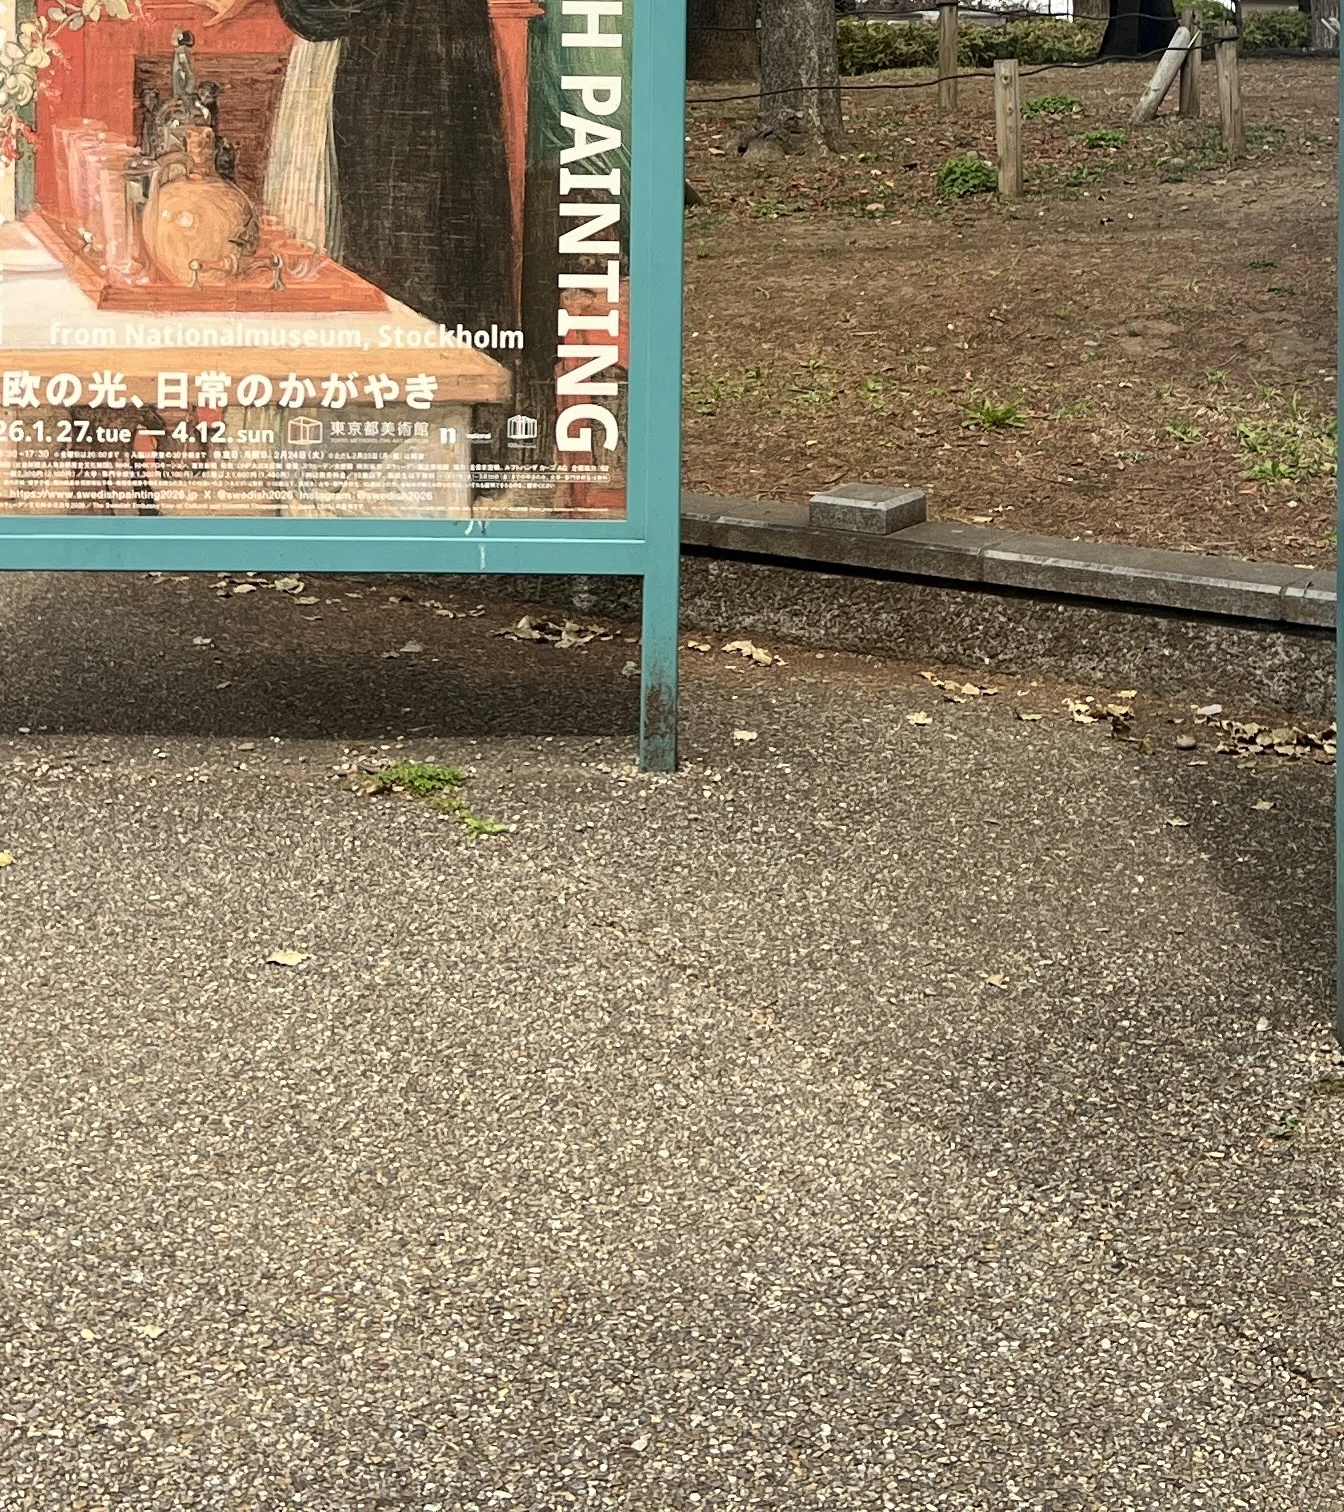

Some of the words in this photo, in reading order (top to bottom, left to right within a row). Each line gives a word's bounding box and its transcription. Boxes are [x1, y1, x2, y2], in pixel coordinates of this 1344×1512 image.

[555, 76, 623, 454] PAINTING
[50, 322, 118, 347] from
[125, 322, 369, 352] Nationalmuseum,
[378, 324, 524, 350] Stockholm
[330, 420, 430, 438] 東京都美術館
